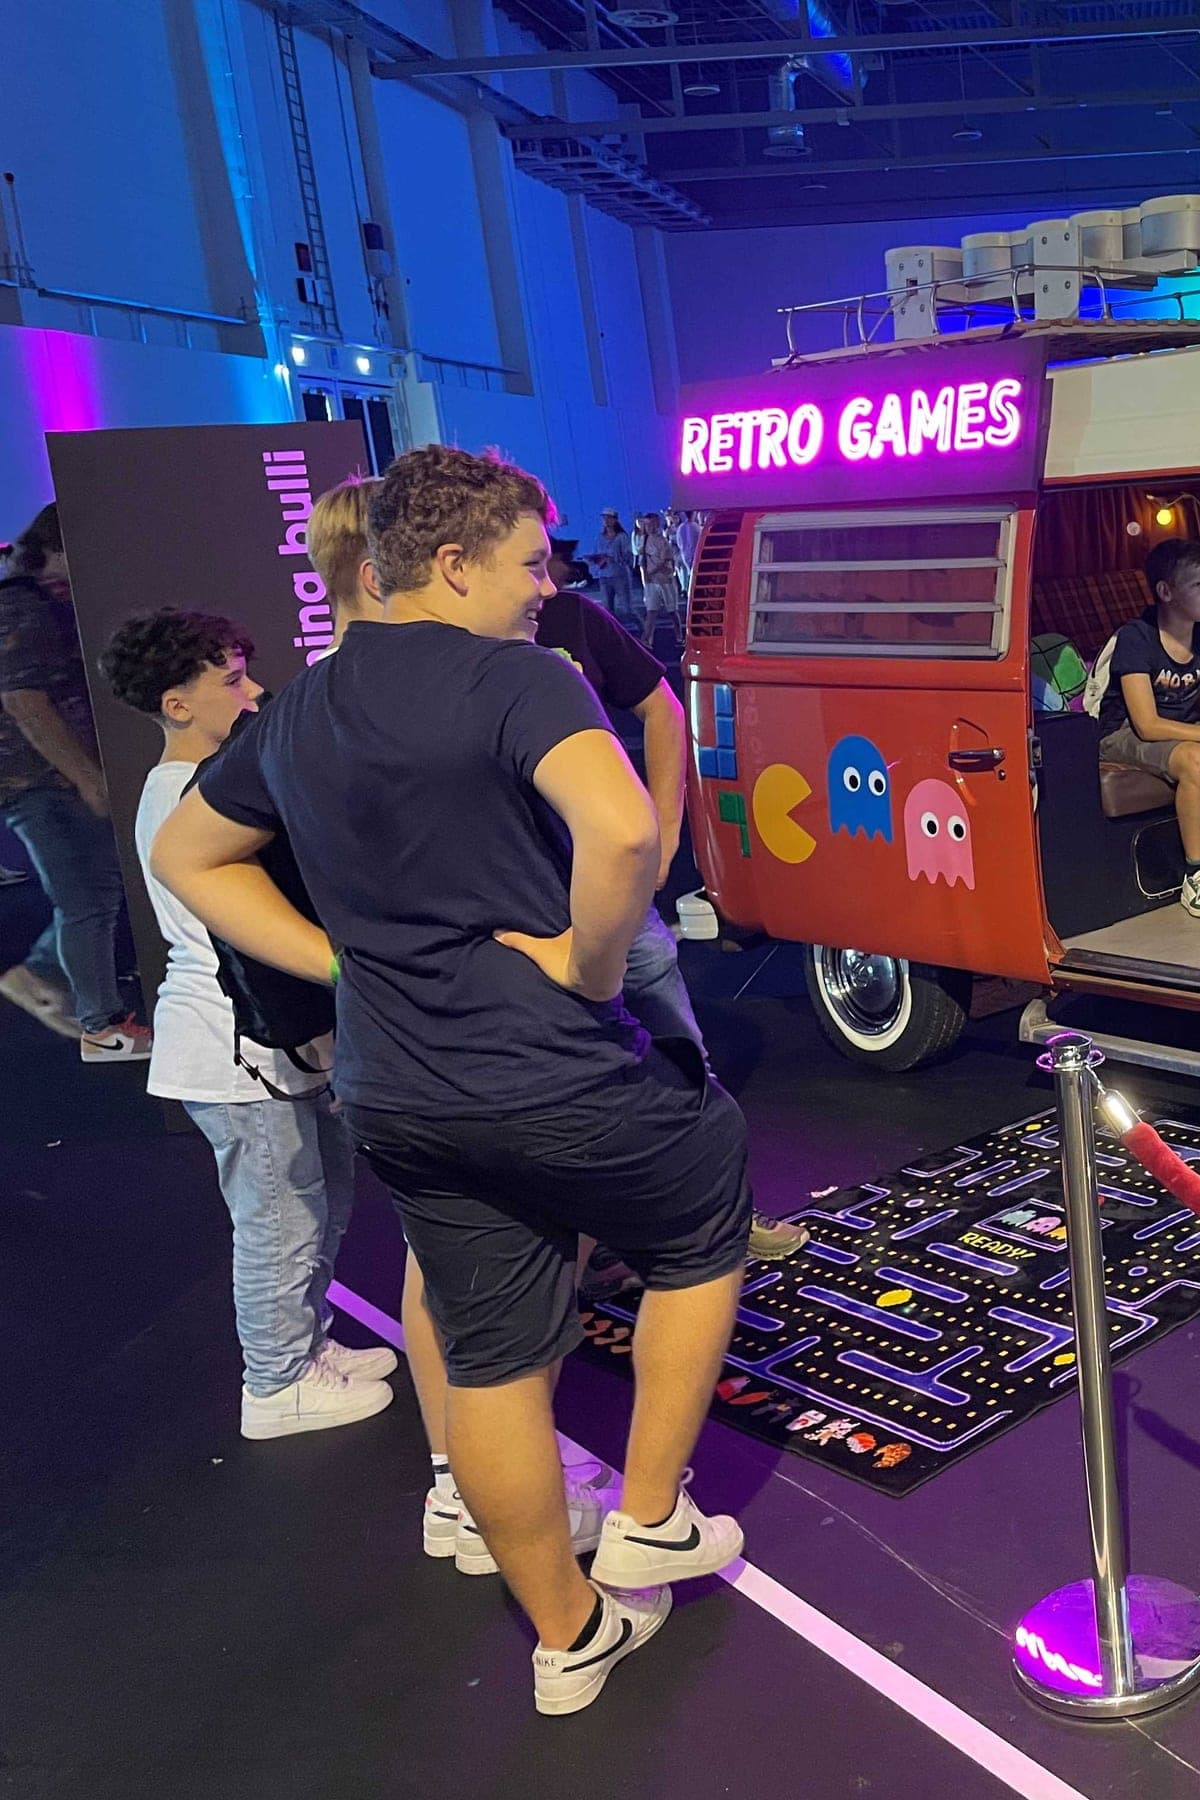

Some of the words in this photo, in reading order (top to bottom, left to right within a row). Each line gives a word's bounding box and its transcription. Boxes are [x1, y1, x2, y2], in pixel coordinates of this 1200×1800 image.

[680, 403, 824, 475] RETRO
[838, 378, 1022, 460] GAMES
[262, 450, 314, 555] bulli
[293, 571, 335, 667] ing
[957, 1231, 1038, 1260] READY!
